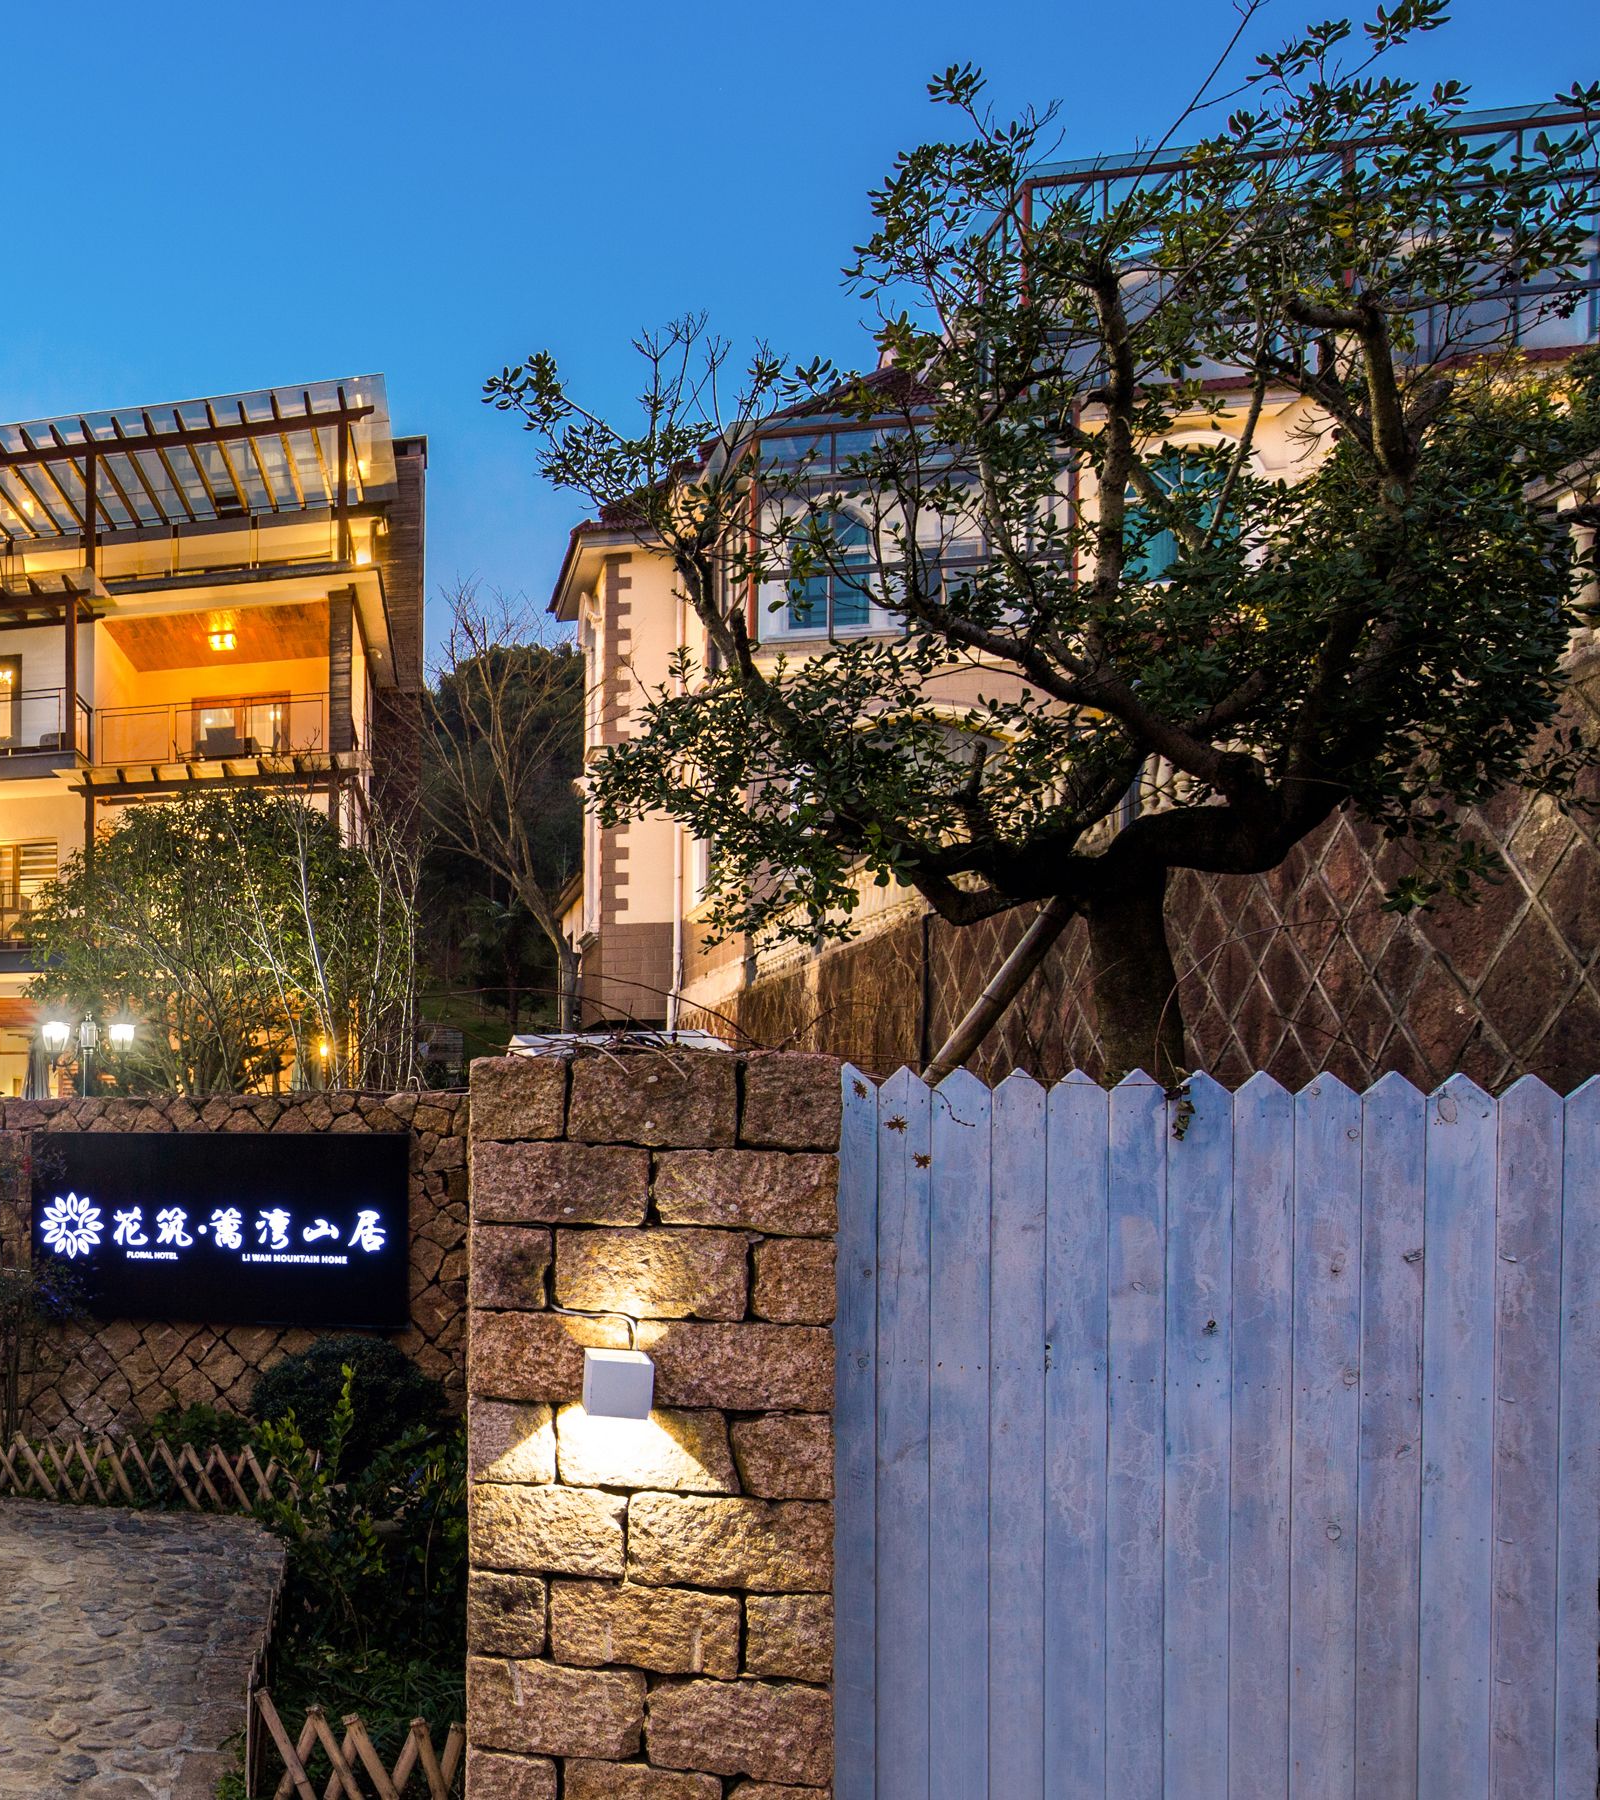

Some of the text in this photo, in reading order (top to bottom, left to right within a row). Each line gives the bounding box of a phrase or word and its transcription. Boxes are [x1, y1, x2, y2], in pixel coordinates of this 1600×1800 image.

[126, 1250, 179, 1260] FLORAL HOTEL
[242, 1253, 348, 1265] LI WAN MOUNTAIN HOME
